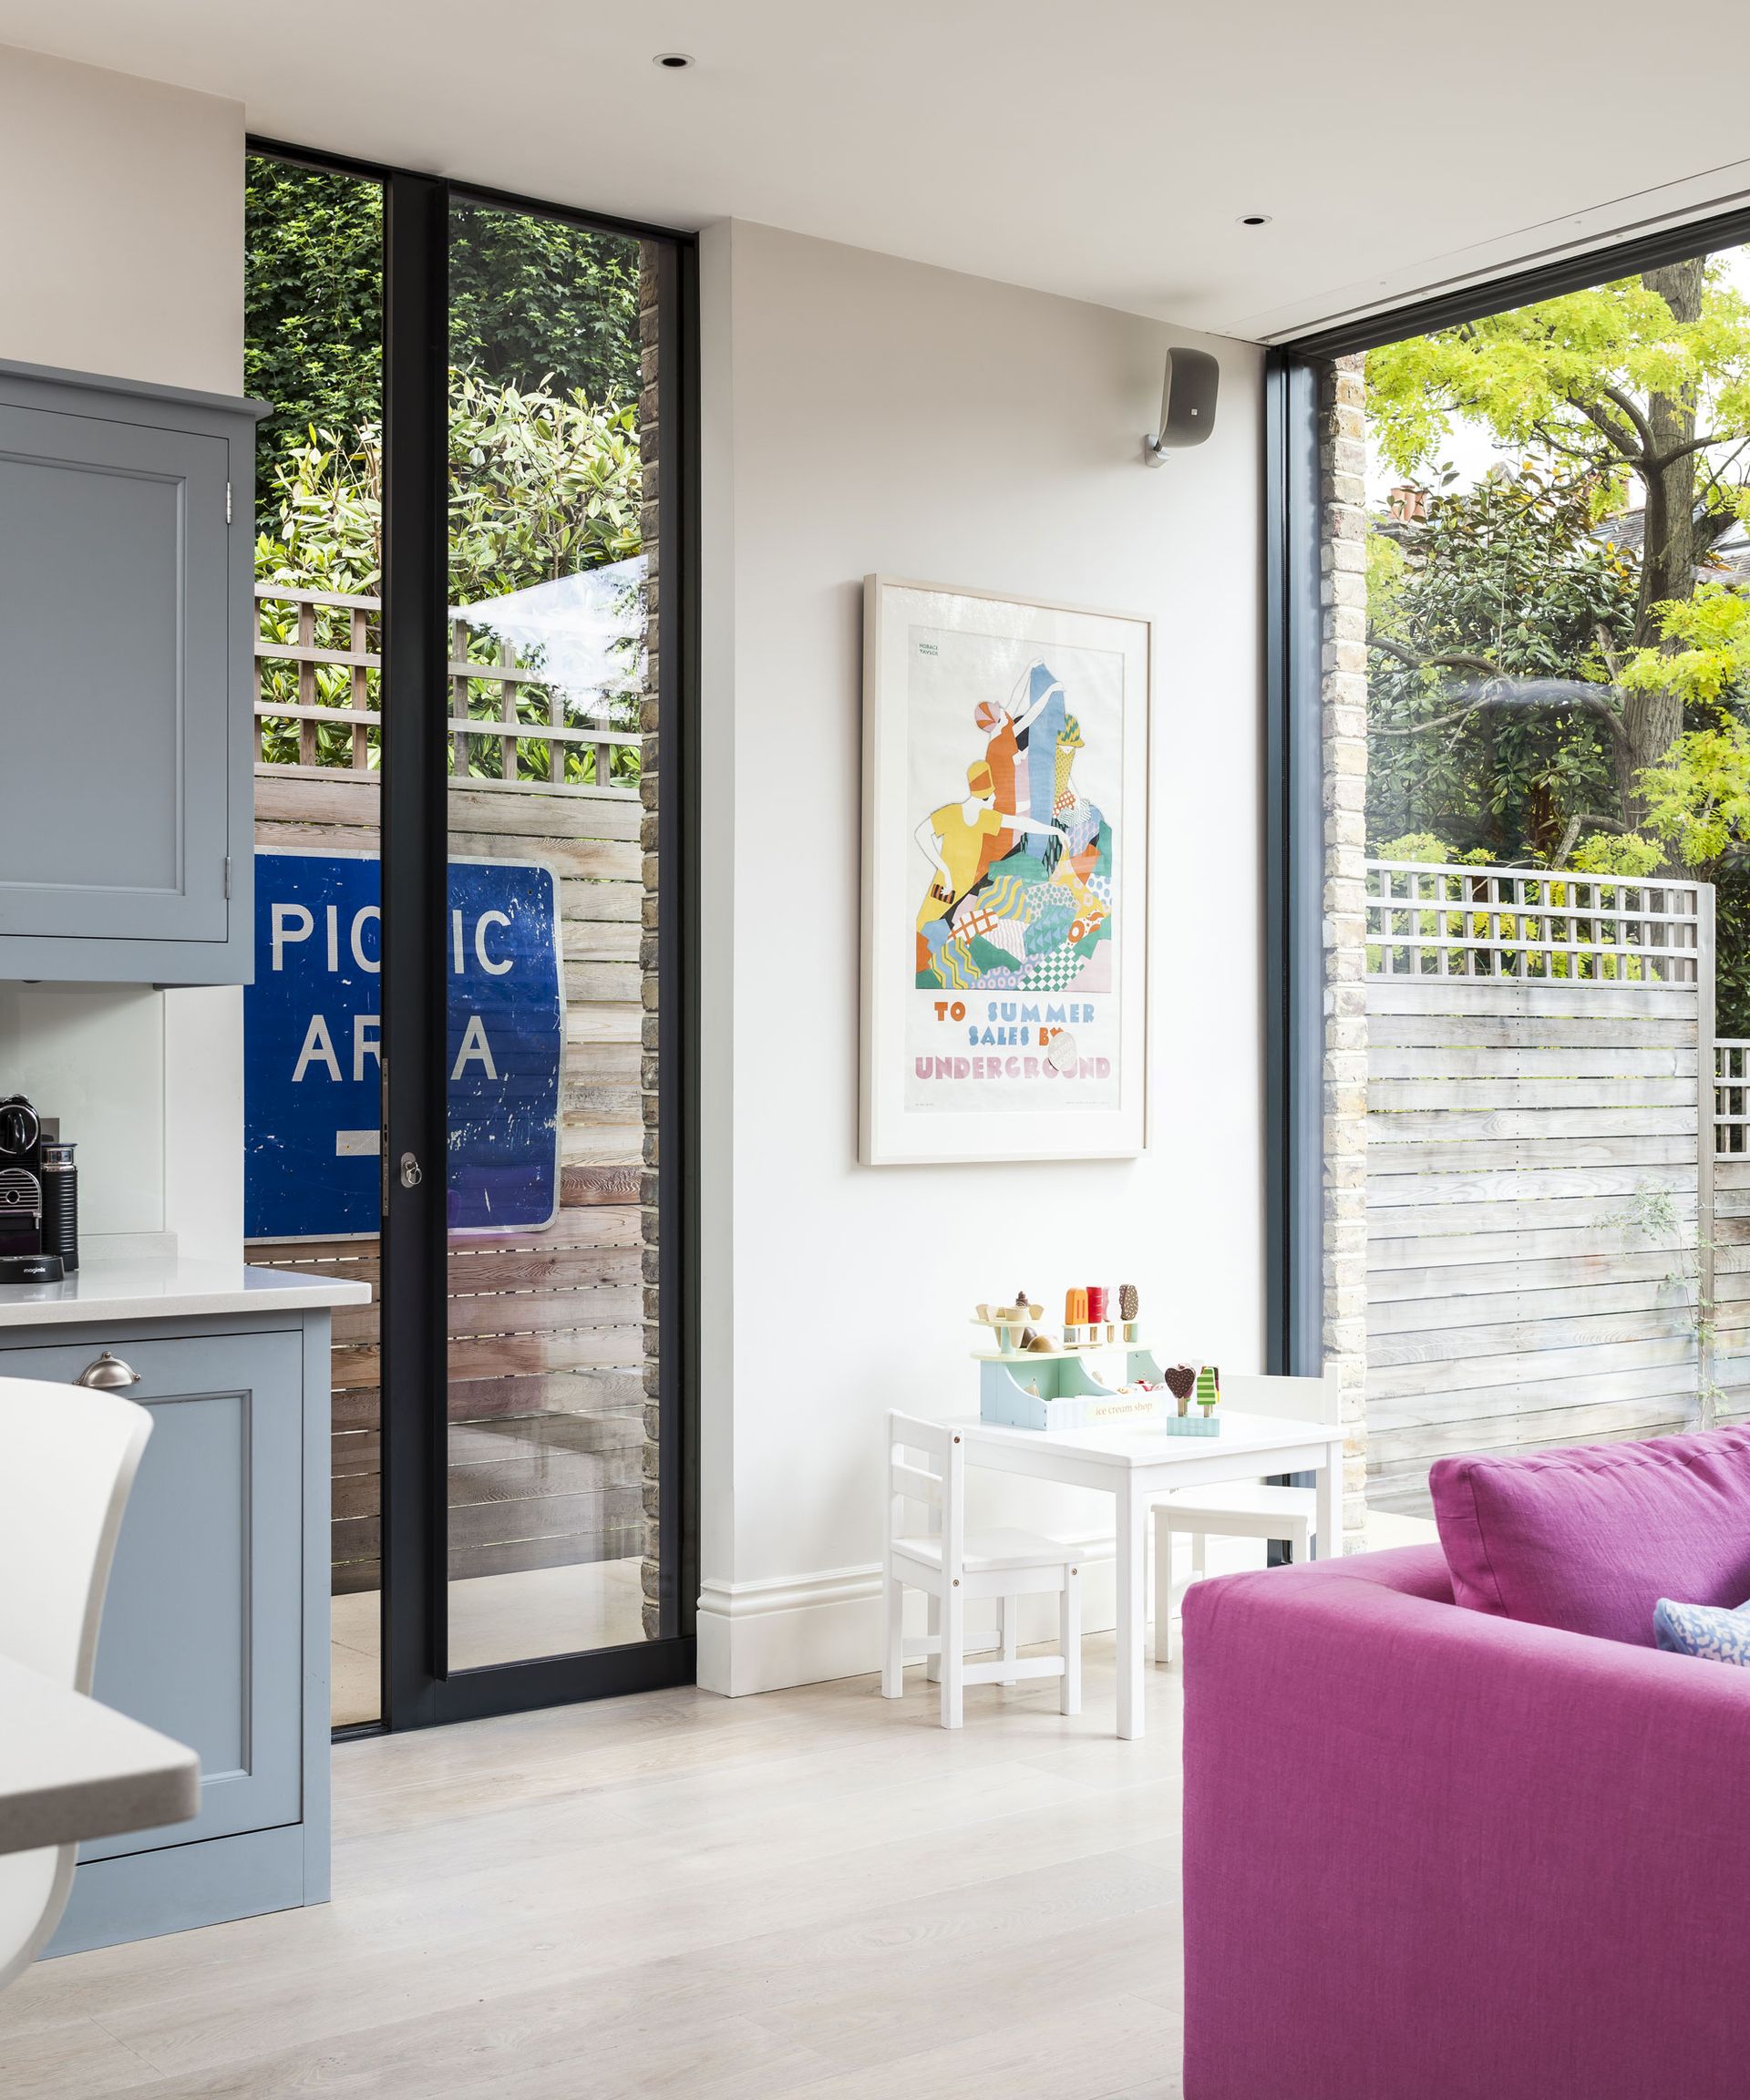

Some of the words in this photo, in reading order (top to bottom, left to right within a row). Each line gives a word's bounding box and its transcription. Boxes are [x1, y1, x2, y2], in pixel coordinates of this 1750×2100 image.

[271, 903, 514, 975] PICIC
[934, 1002, 966, 1022] TO
[987, 1002, 1096, 1023] SUMMER
[968, 1025, 1030, 1046] SALES
[292, 1014, 499, 1082] ARA
[1096, 1405, 1107, 1415] ice
[1108, 1405, 1133, 1415] cream
[1134, 1402, 1153, 1413] shop
